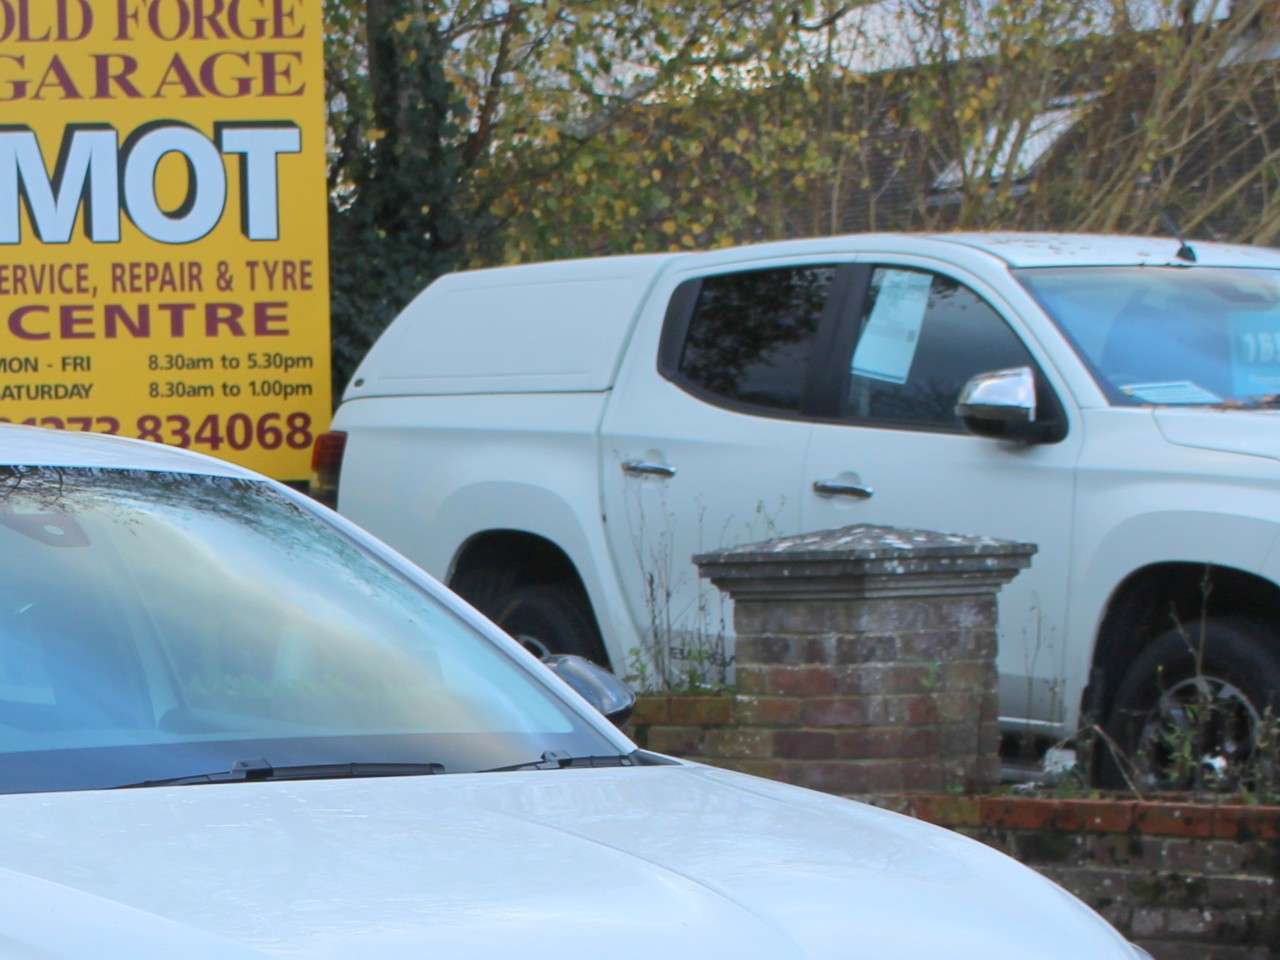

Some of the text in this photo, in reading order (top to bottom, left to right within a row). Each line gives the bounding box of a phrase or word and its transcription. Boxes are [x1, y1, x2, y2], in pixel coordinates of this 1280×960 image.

[114, 0, 306, 42] FORGE
[112, 261, 203, 293] REPAIR
[216, 261, 233, 291] &
[246, 259, 313, 291] TYRE
[7, 301, 290, 340] CENTRE
[61, 356, 92, 371] FRI
[148, 354, 214, 370] 8.30am
[221, 355, 240, 369] to
[247, 352, 314, 374] 5.30pm
[149, 381, 214, 398] 8.30am
[222, 383, 241, 397] to
[249, 380, 313, 402] 1.00pm
[136, 412, 314, 450] 834068
